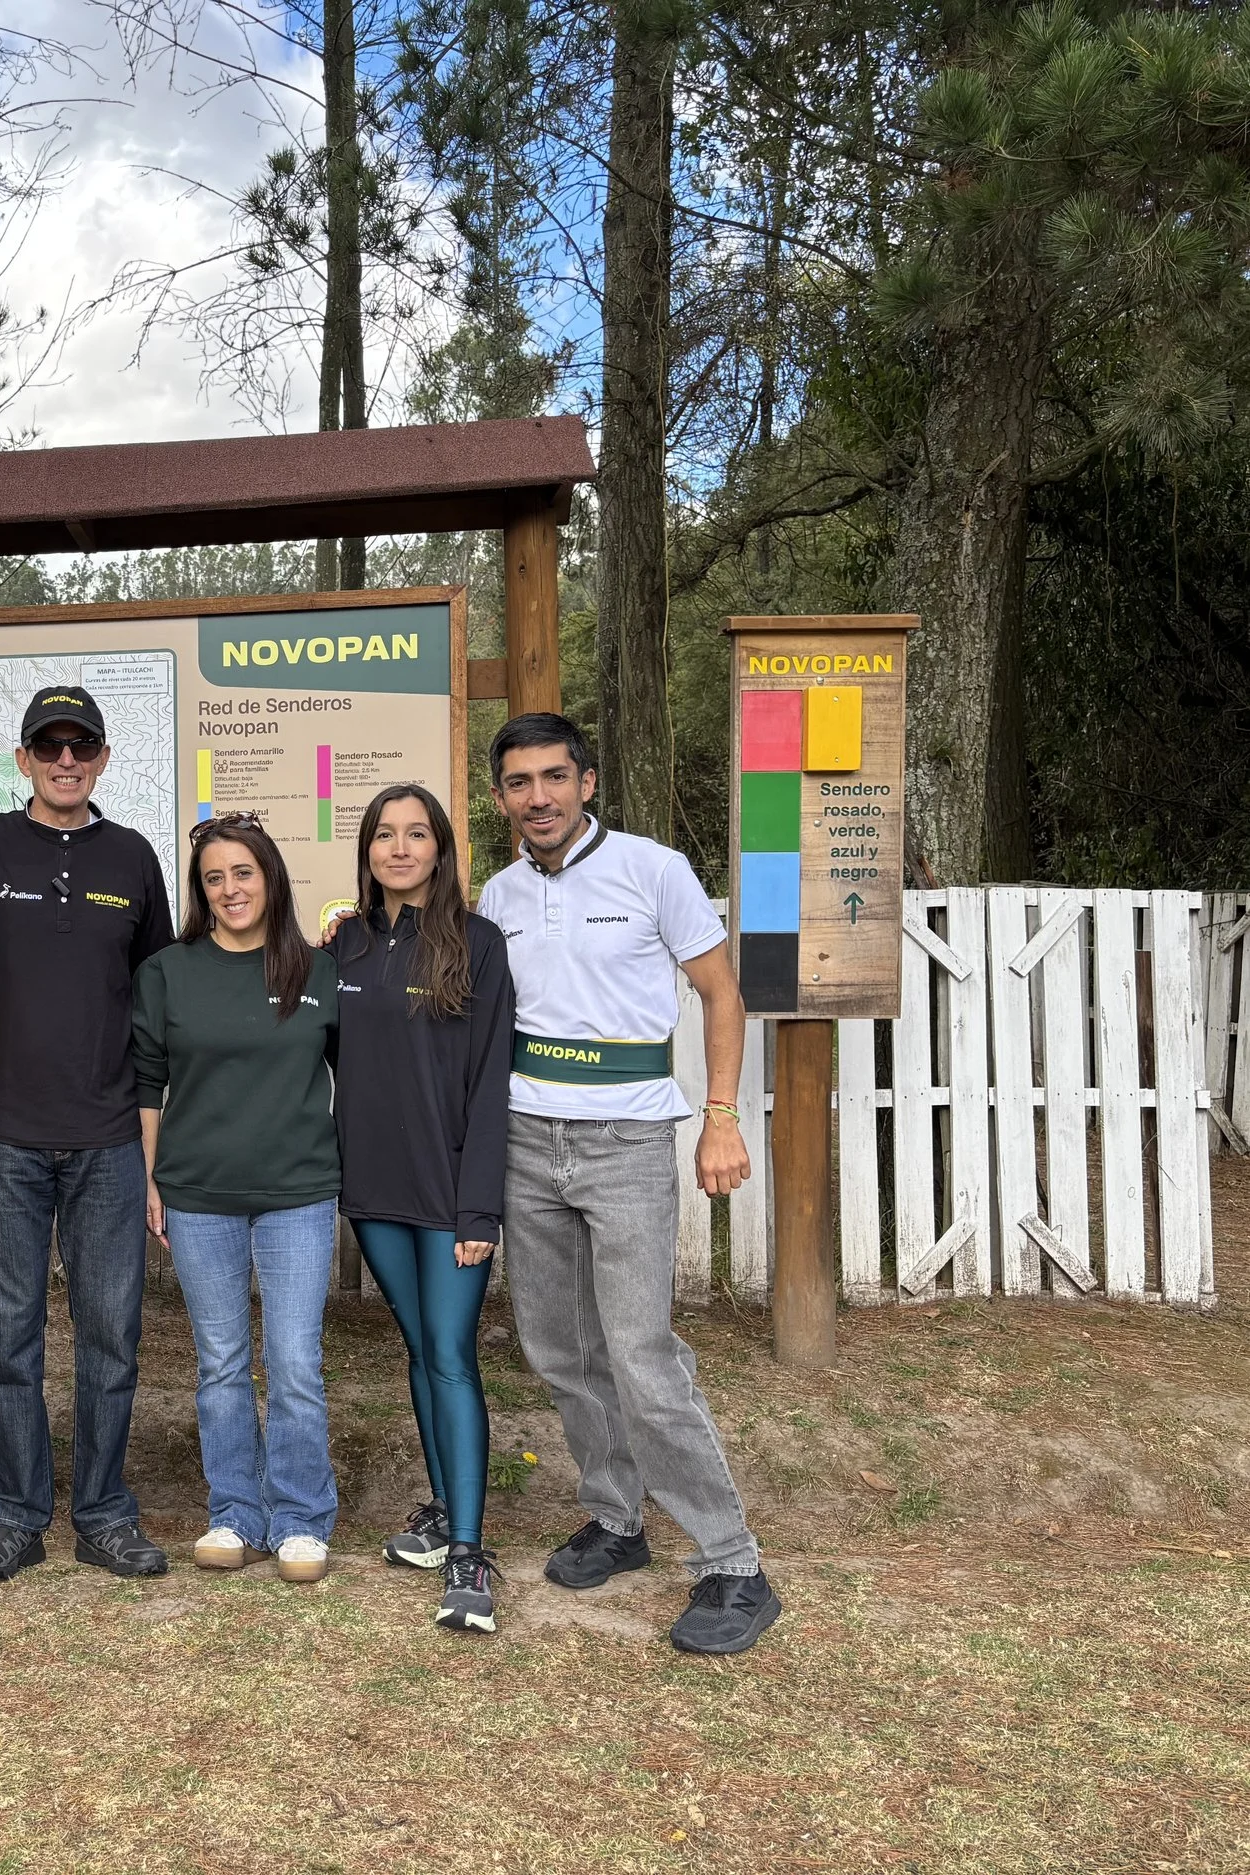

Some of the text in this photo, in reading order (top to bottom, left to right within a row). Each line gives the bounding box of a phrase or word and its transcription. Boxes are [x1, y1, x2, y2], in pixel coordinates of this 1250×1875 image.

[222, 633, 419, 668] NOVOPAN
[749, 654, 893, 675] NOVOPAN
[42, 695, 83, 707] NOVOPAN
[198, 697, 352, 716] Red de Senderos
[198, 720, 279, 737] Novopan
[214, 747, 285, 757] Sendero Amarillo
[334, 751, 403, 760] Sendero Rosado
[229, 759, 274, 767] Recomendado
[820, 782, 890, 796] Sendero
[252, 808, 269, 816] Azul
[823, 803, 886, 819] rosado,
[828, 823, 880, 840] verde,
[830, 844, 878, 860] azul y
[830, 867, 878, 881] negro
[10, 891, 43, 900] Pelikano
[86, 892, 129, 907] NOVOPAN
[586, 916, 629, 924] NOVOPAN
[406, 986, 434, 996] NOVO
[268, 995, 319, 1007] NPAN
[526, 1041, 601, 1064] NOVOPAN
